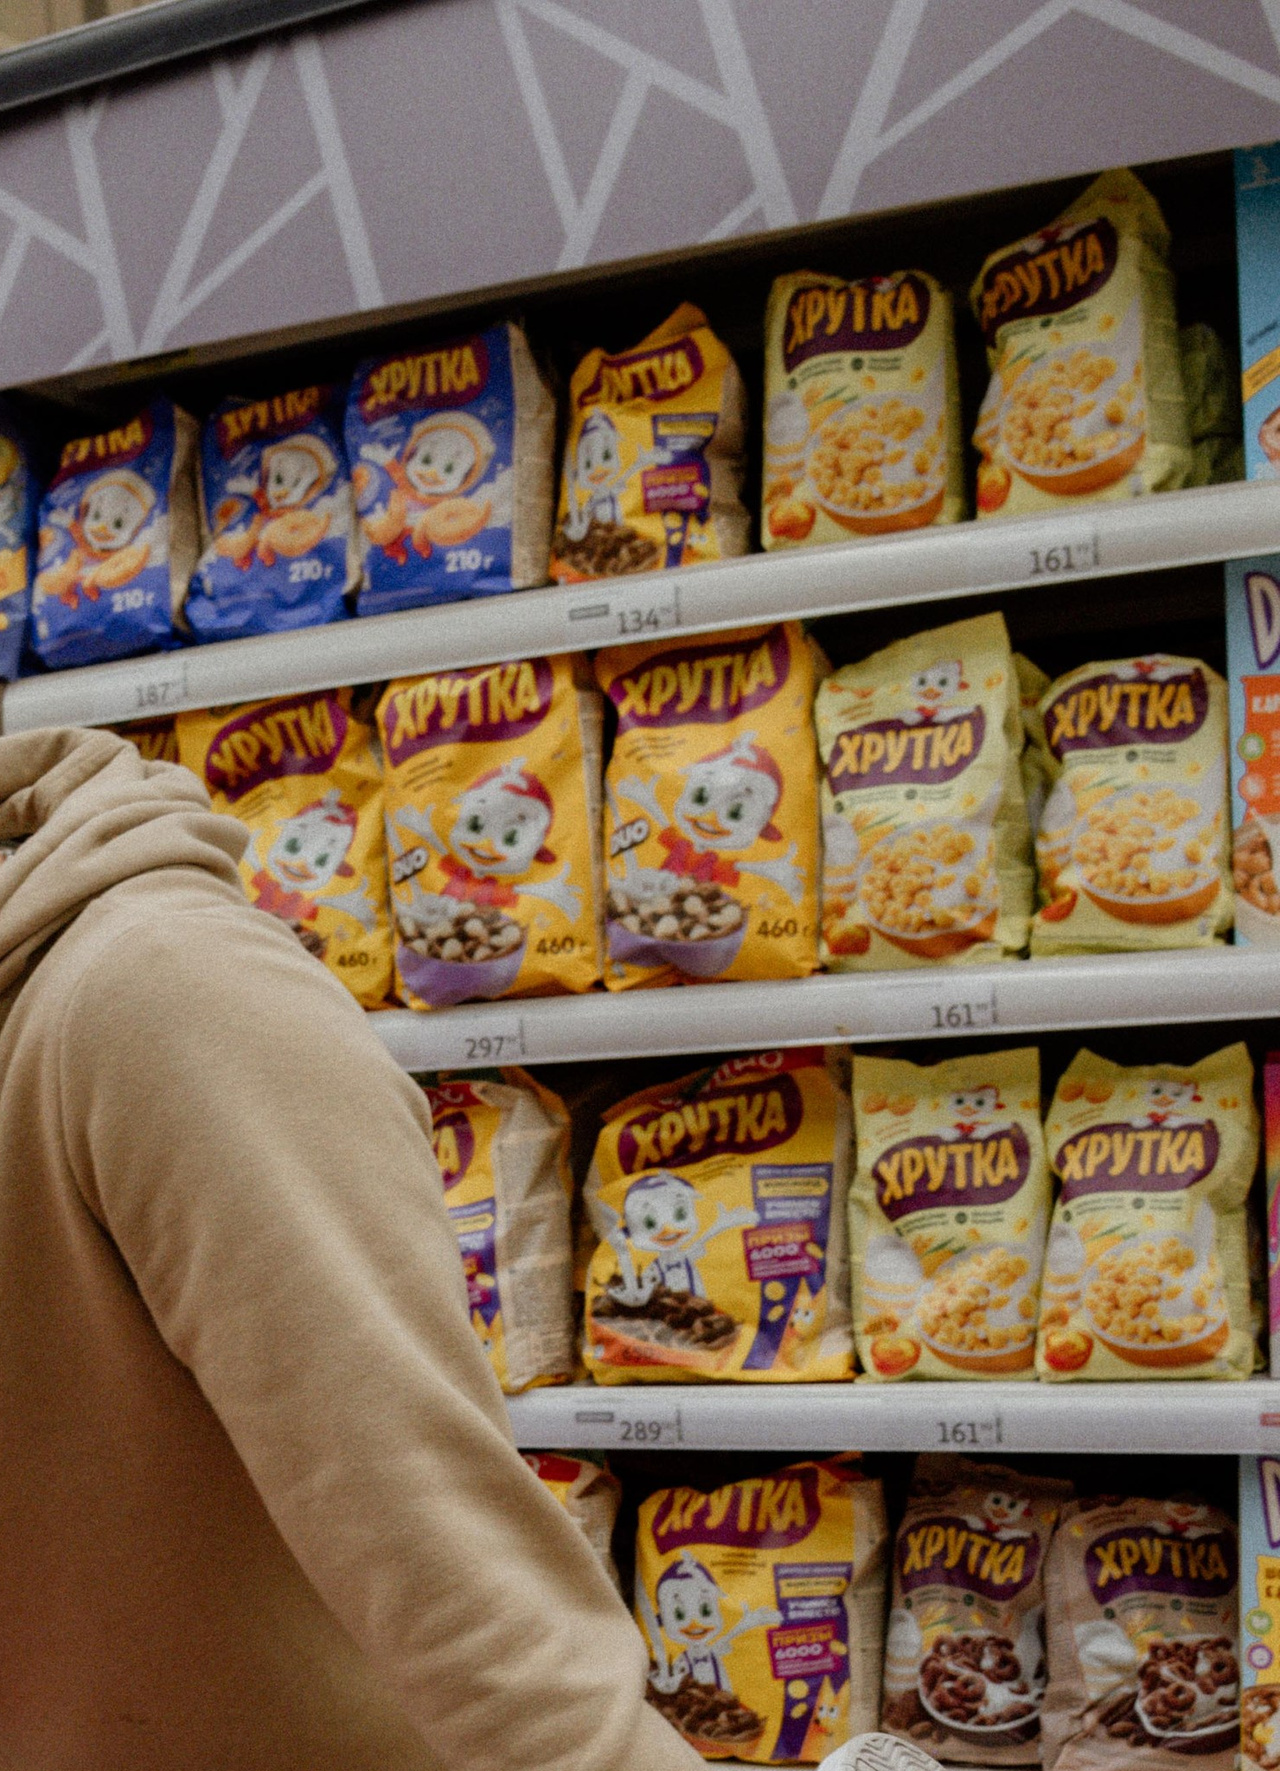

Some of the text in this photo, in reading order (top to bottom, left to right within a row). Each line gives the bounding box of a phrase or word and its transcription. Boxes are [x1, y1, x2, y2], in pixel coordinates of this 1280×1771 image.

[980, 232, 1105, 332] ХРУТКА
[787, 282, 919, 353] ХРУТКА
[366, 345, 481, 411] ХРУТКА
[289, 559, 321, 583] 210
[445, 549, 482, 573] 210
[1030, 545, 1075, 575] 161
[112, 589, 144, 613] 210
[391, 660, 542, 749] ХРУТКА
[619, 643, 778, 718] ХРУТКА
[1051, 682, 1196, 746] ХРУТКА
[831, 718, 975, 779] ХРУТКА
[610, 816, 650, 852] DUO
[536, 936, 573, 955] 460
[756, 918, 797, 940] 460
[337, 951, 369, 967] 460
[931, 1003, 975, 1028] 161
[465, 1036, 504, 1059] 297
[631, 1089, 788, 1172] ХРУТКА
[1061, 1130, 1206, 1181] ХРУТКА
[875, 1137, 1018, 1205] ХРУТКА
[620, 1420, 662, 1441] 289
[936, 1422, 980, 1443] 161
[658, 1477, 808, 1538] ХРУТКА
[903, 1526, 1027, 1586] ХРУТКА
[1095, 1538, 1229, 1588] ХРУТКА
